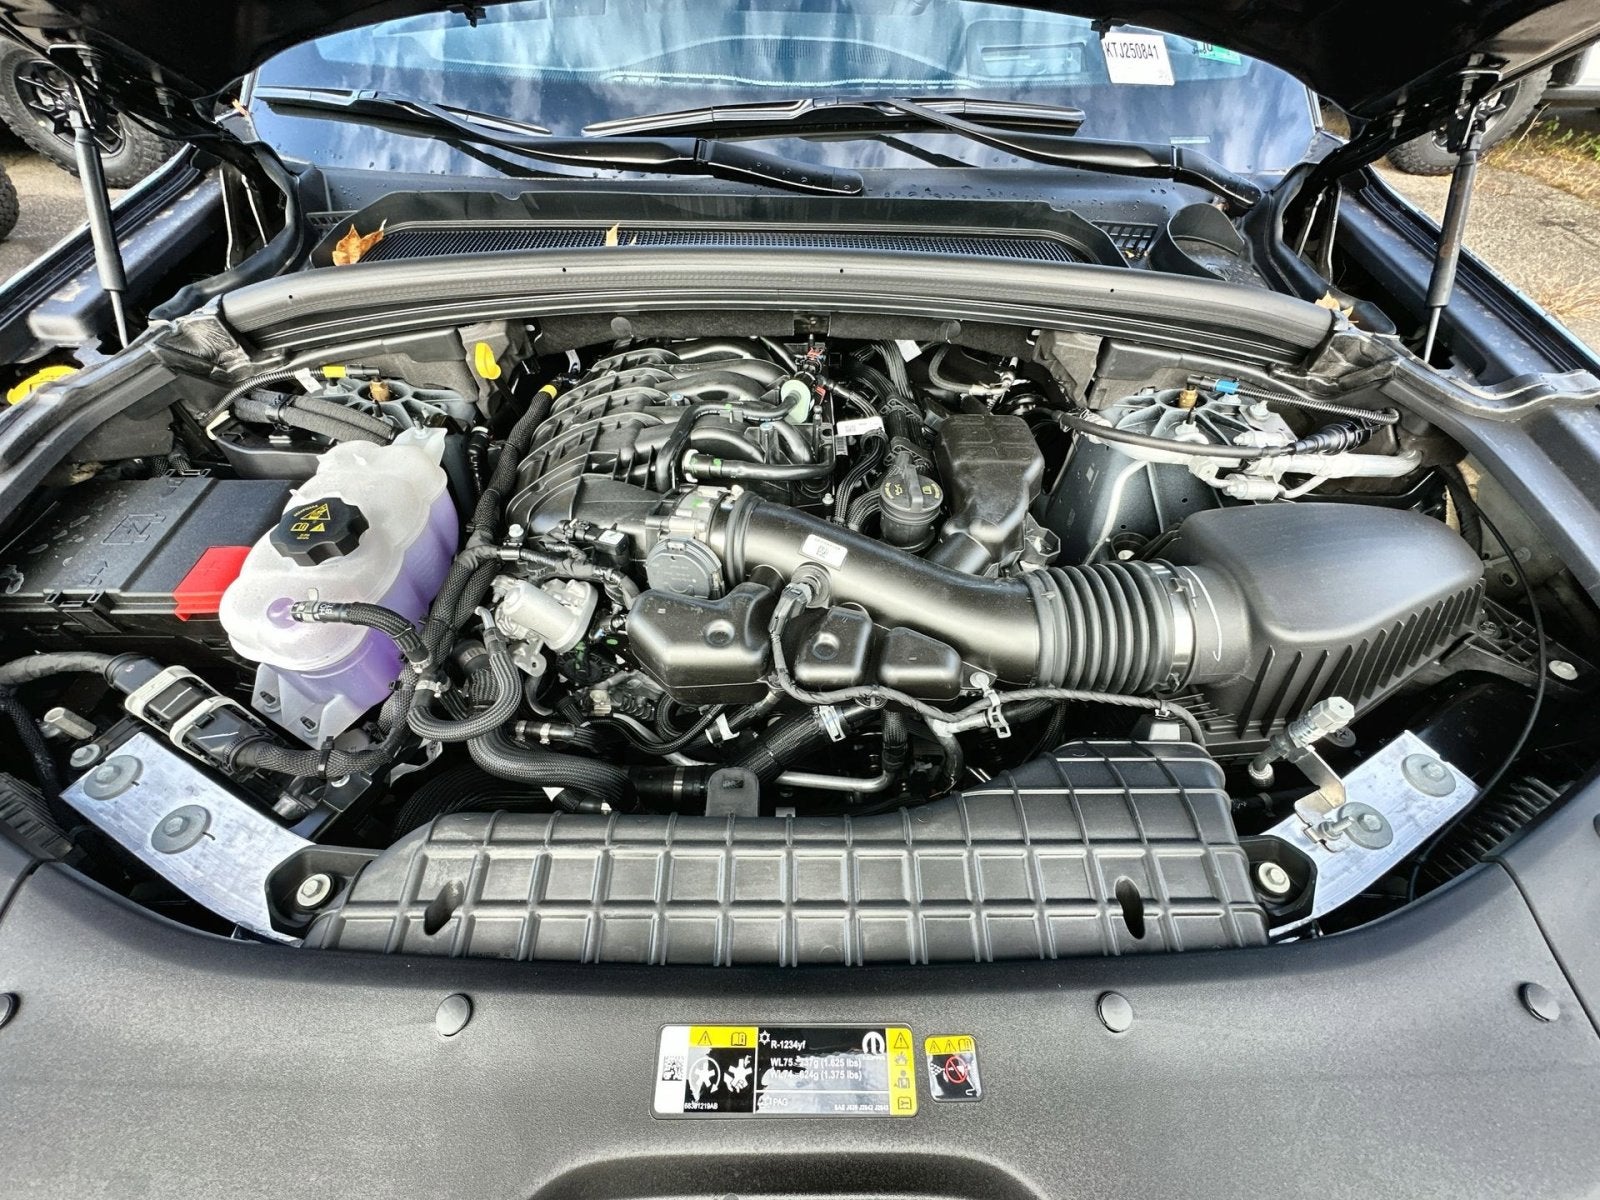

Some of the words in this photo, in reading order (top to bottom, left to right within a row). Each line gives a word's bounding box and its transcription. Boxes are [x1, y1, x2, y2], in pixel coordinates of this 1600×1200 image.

[1104, 42, 1159, 60] KTJ250841
[770, 1040, 806, 1051] R-1234yf
[770, 1058, 793, 1067] WL75
[821, 1058, 845, 1069] (1.625
[847, 1058, 861, 1069] lbs)
[821, 1070, 845, 1081] (1.375
[847, 1070, 862, 1081] lbs)
